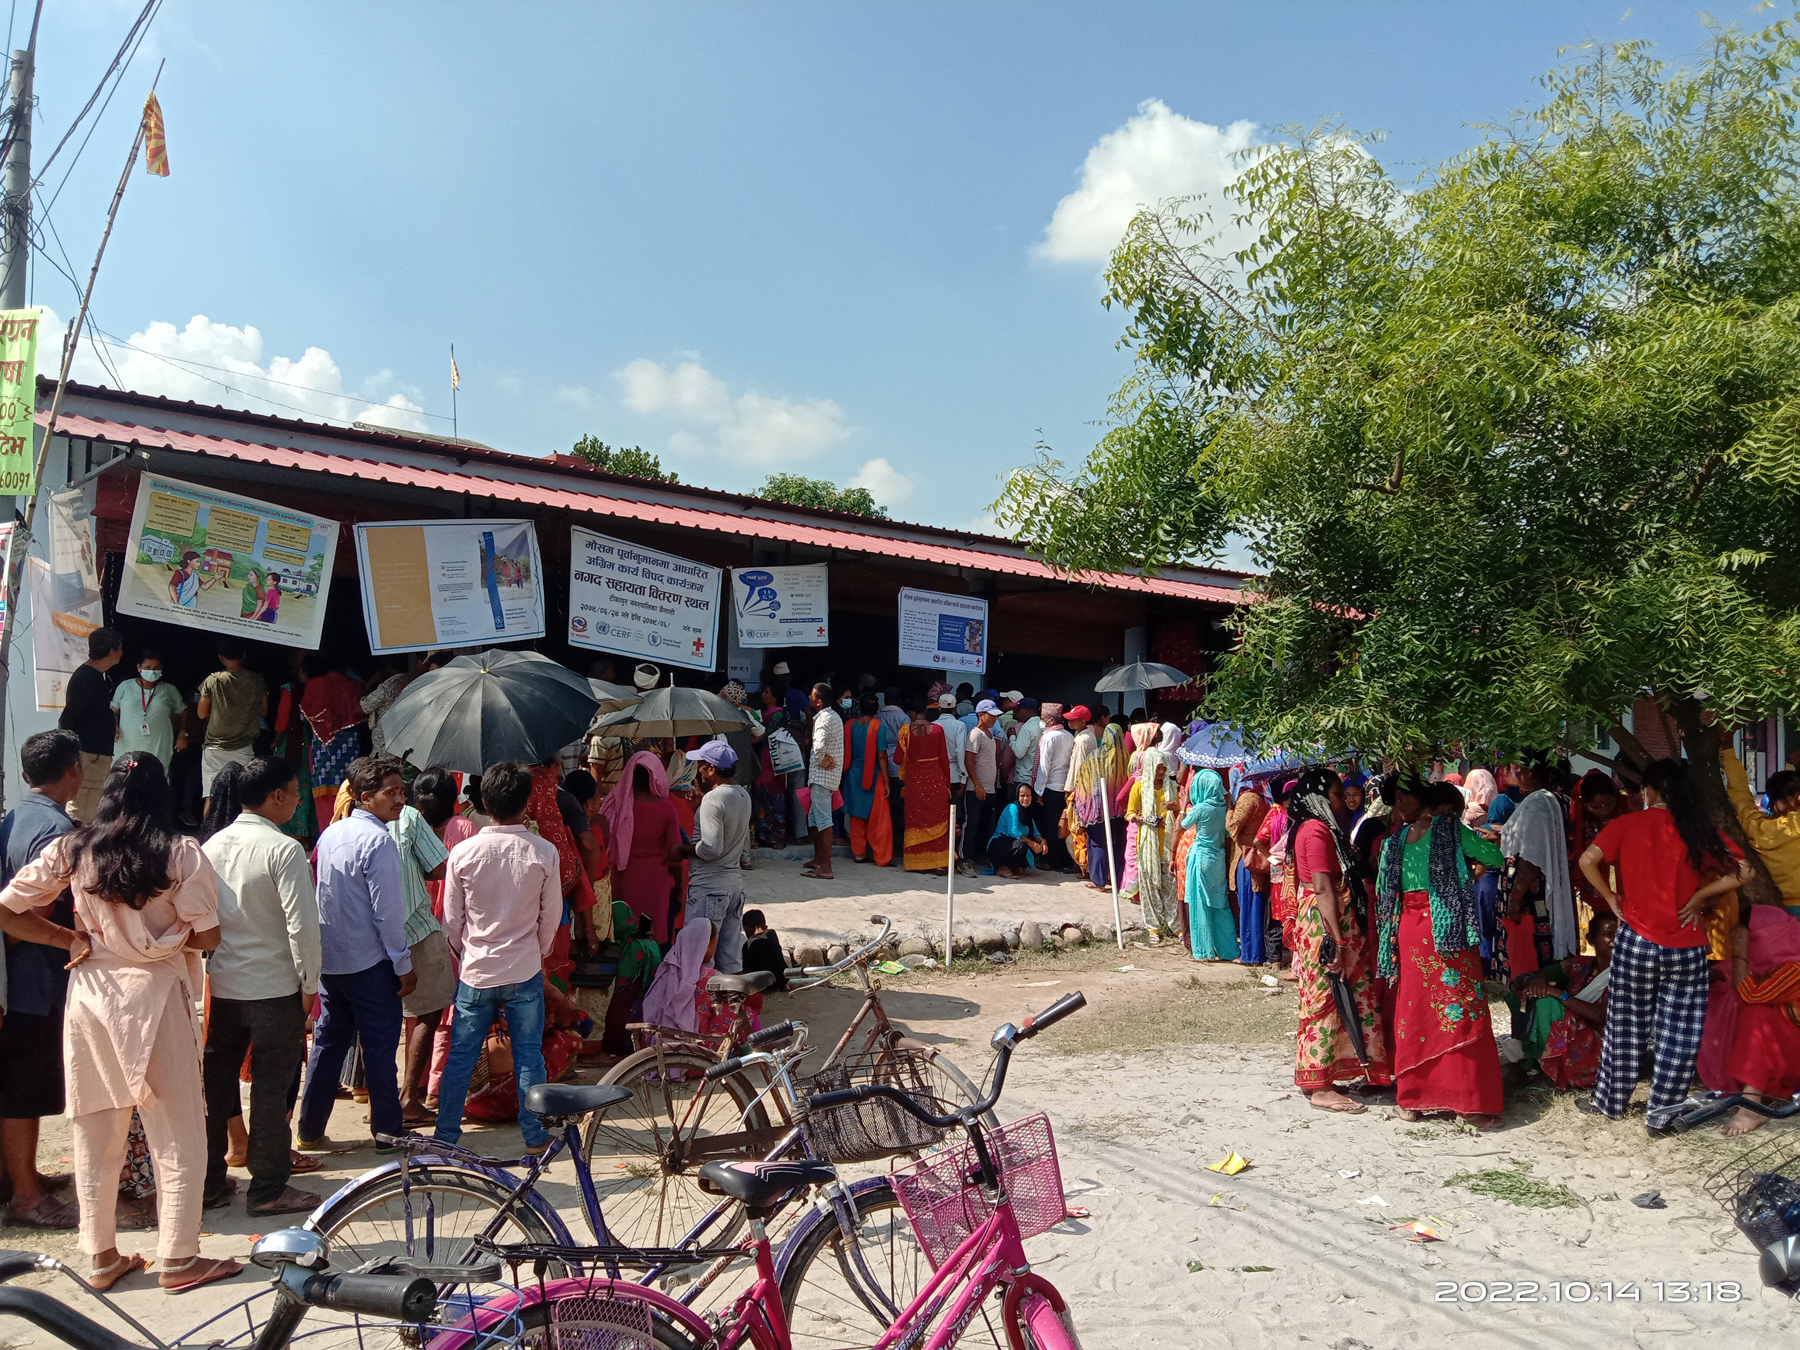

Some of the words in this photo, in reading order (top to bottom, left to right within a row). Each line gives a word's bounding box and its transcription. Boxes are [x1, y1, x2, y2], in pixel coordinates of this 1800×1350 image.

[0, 361, 25, 384] षा
[585, 540, 614, 555] मौसम
[618, 548, 670, 570] पूर्वानुमानमा
[586, 556, 615, 571] अग्रिम
[618, 562, 639, 576] कार्य
[667, 575, 704, 592] कार्यक्रम
[574, 570, 603, 586] नगद
[606, 577, 647, 596] सहायता
[649, 584, 682, 605] वितरण
[684, 596, 710, 611] स्थल
[610, 628, 632, 639] CERF
